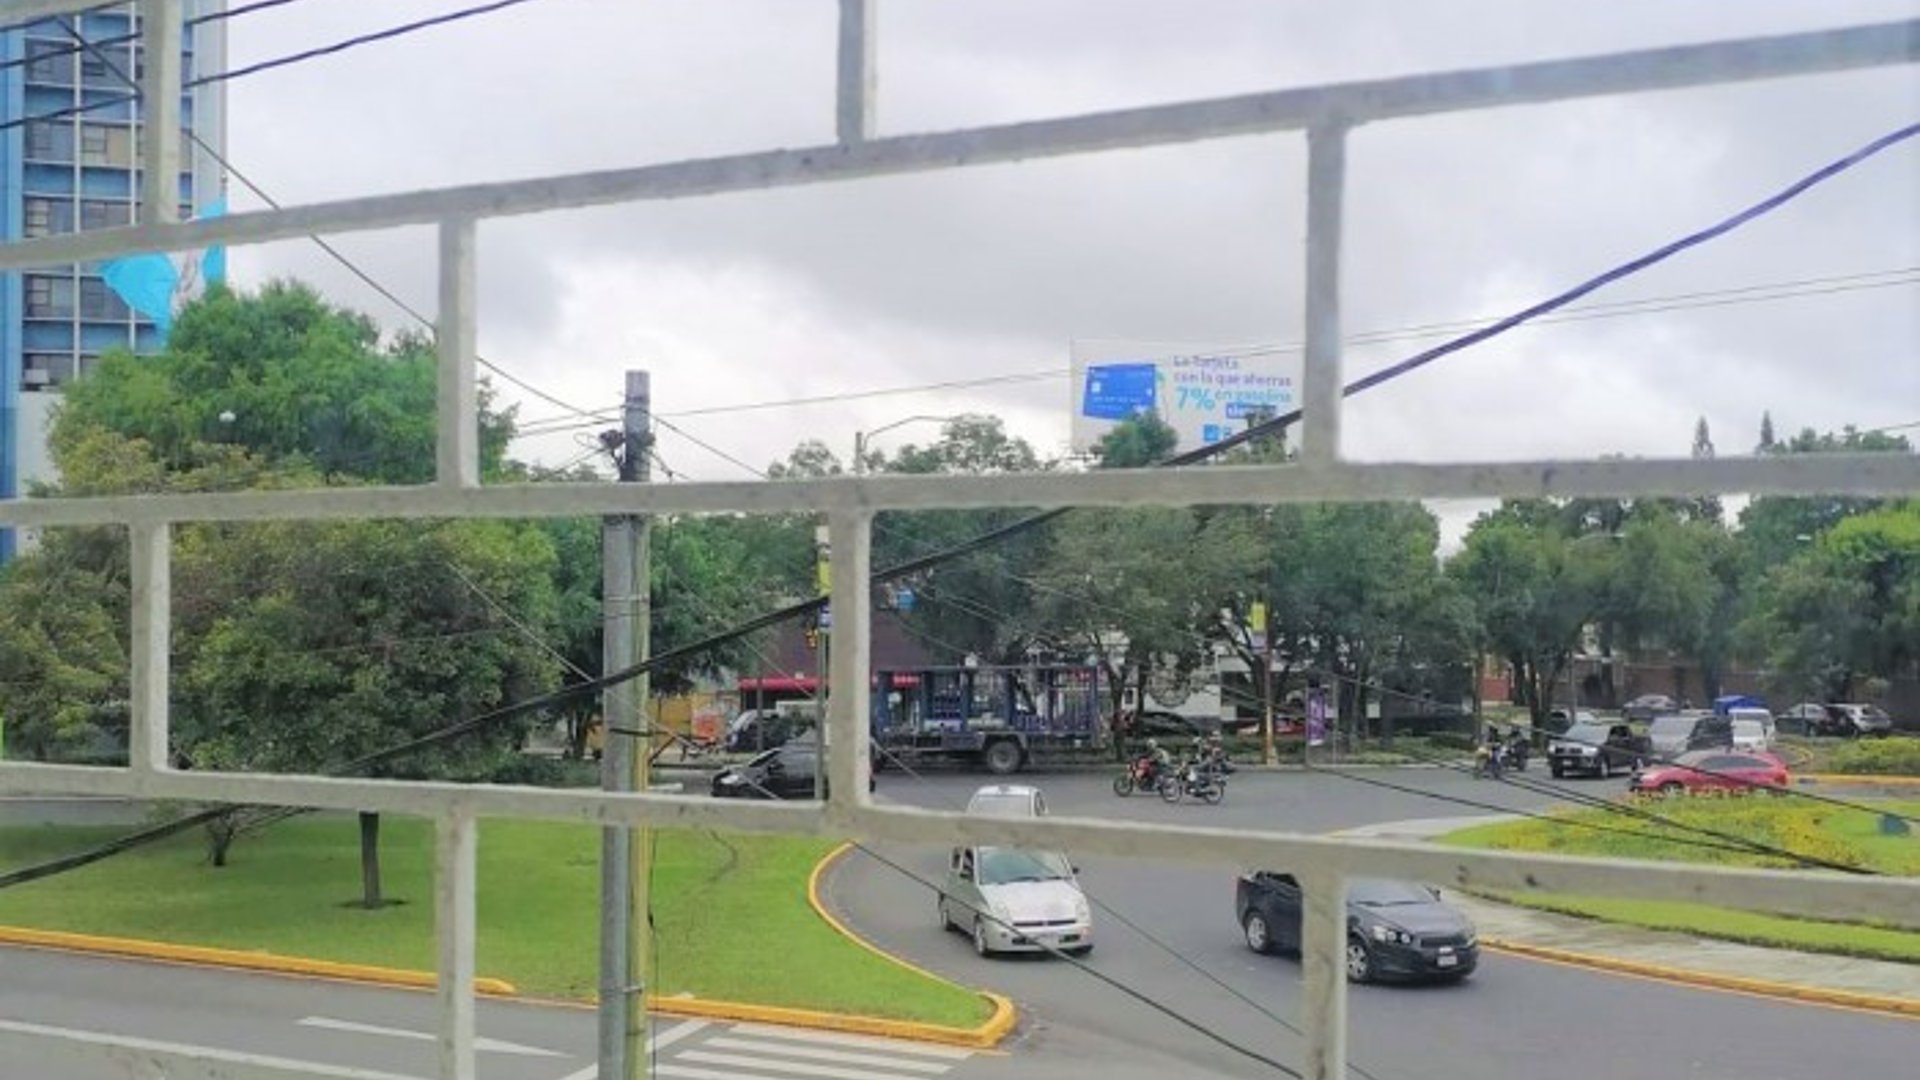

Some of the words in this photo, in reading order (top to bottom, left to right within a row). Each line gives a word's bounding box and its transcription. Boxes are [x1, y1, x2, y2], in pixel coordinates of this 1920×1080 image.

[1174, 355, 1190, 367] La
[1174, 372, 1198, 383] con
[1201, 370, 1213, 383] la
[1215, 375, 1240, 388] que
[1243, 374, 1292, 387] ahorras
[1177, 387, 1216, 411] 7%
[1215, 391, 1232, 400] en
[1235, 389, 1292, 403] gasolina
